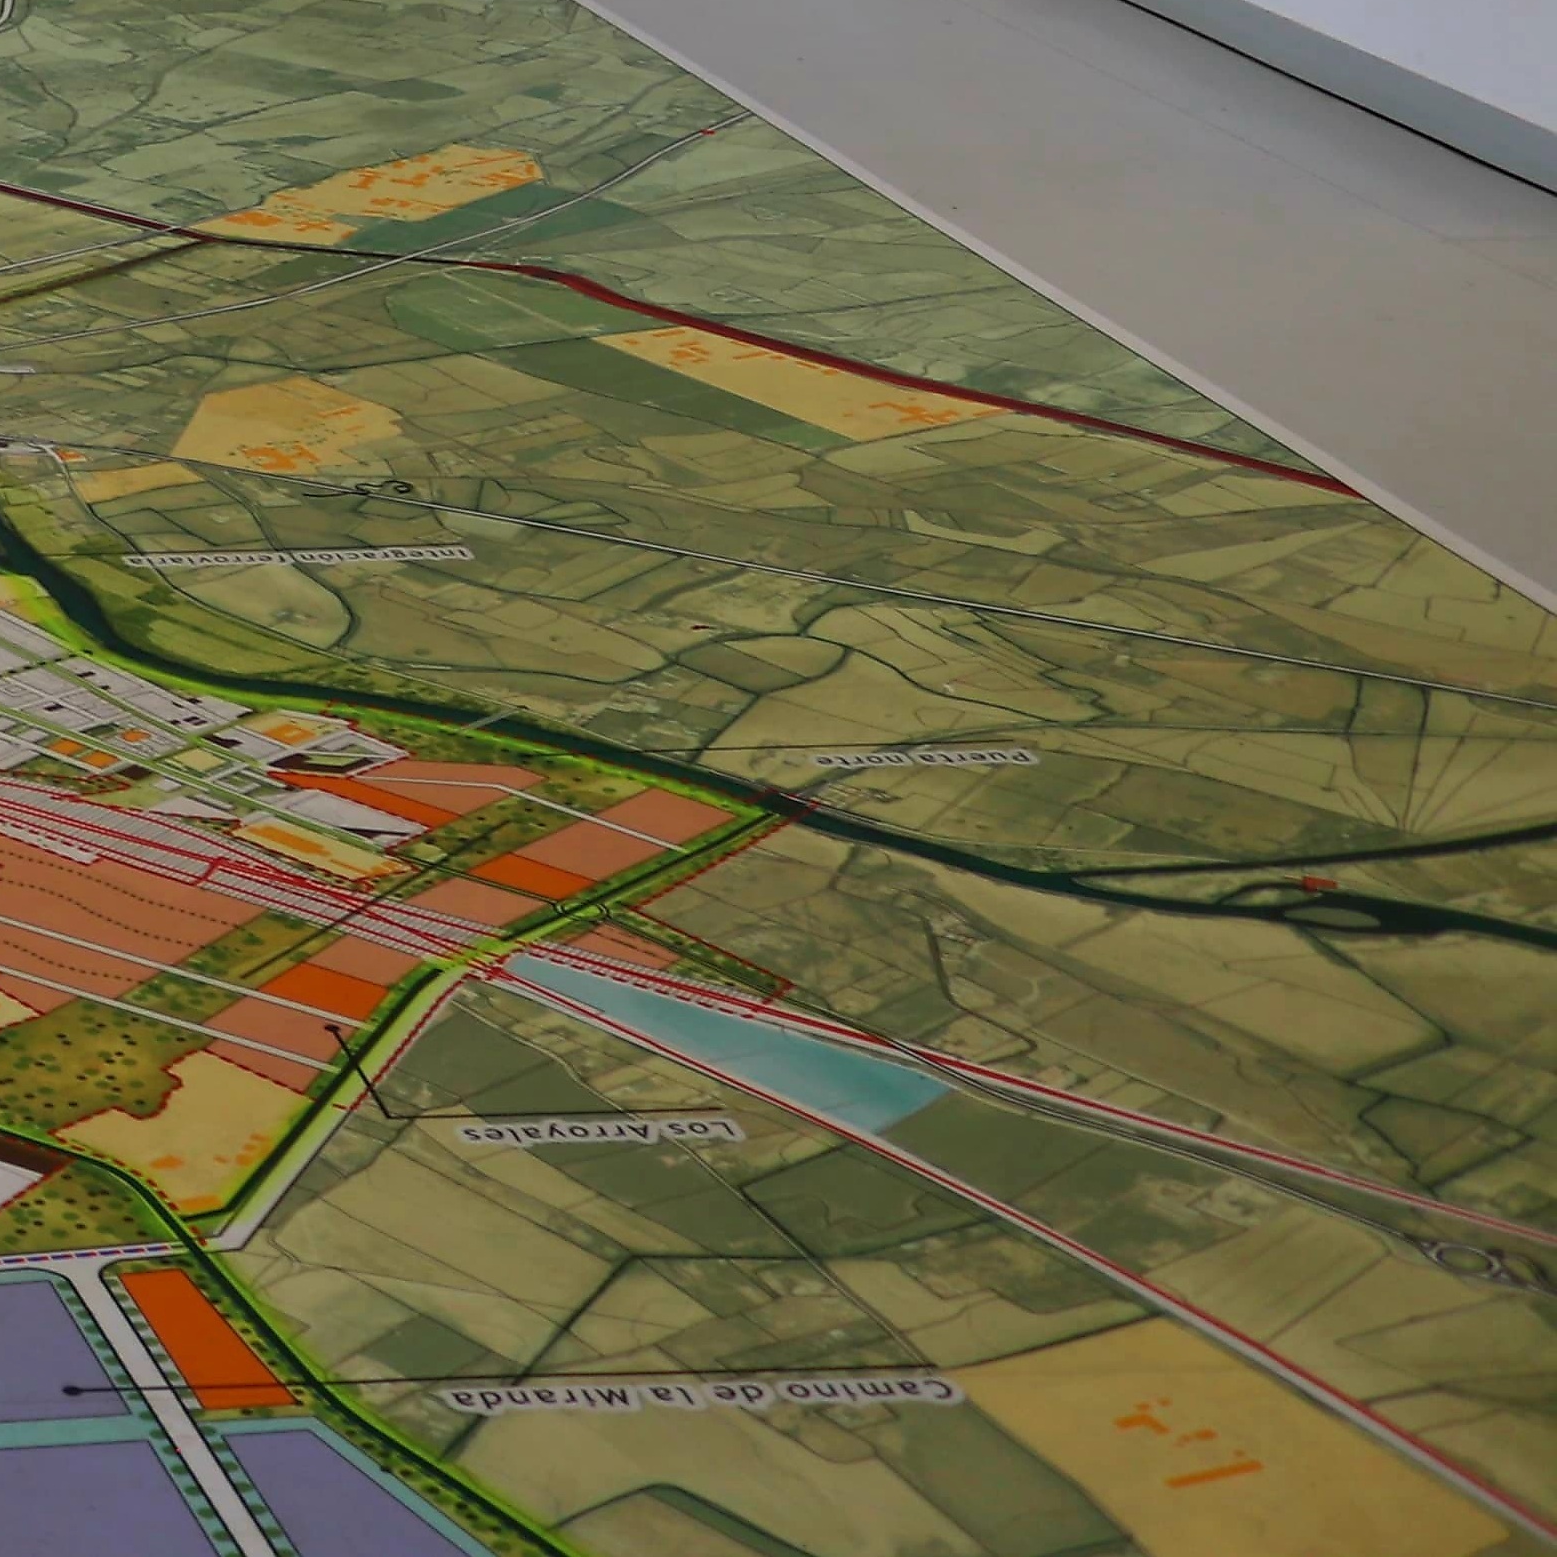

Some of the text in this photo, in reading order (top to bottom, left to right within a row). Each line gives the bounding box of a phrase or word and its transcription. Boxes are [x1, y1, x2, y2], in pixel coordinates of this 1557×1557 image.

[127, 549, 468, 565] Integración ferroviaria
[815, 751, 1031, 768] Puerta norte
[462, 1121, 734, 1143] Los Arroyales
[450, 1380, 953, 1410] Camino de la Miranda
